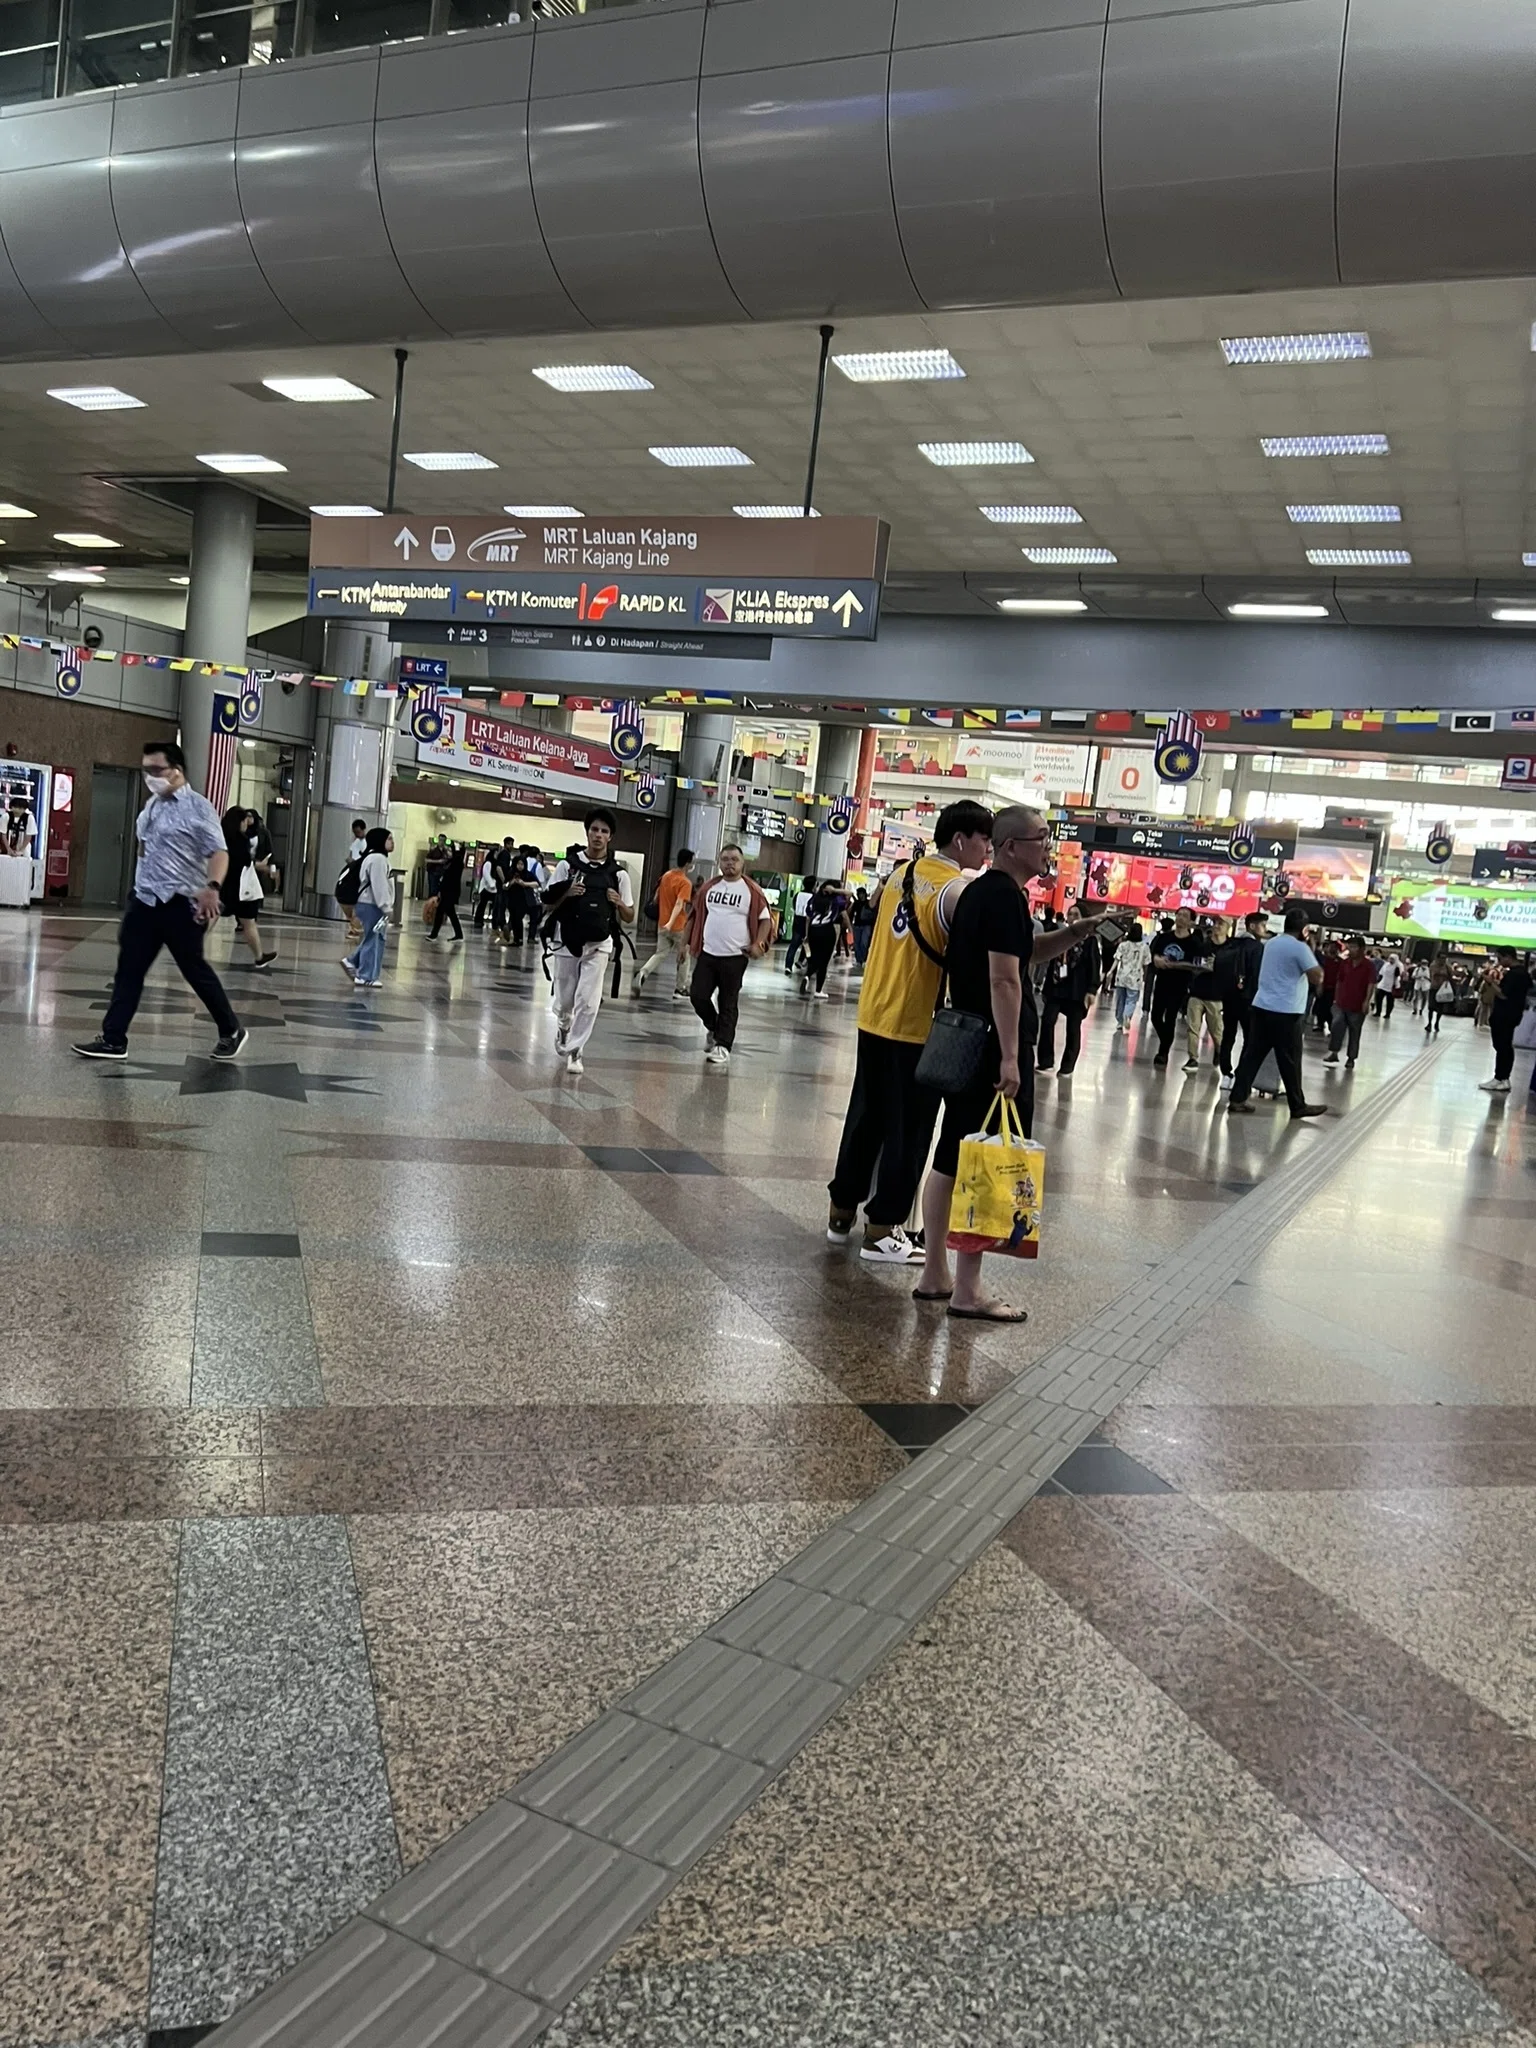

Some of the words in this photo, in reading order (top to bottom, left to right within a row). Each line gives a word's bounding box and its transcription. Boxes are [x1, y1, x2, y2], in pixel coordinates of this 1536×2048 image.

[543, 527, 578, 544] MRT
[582, 528, 636, 545] Laluan
[640, 528, 698, 549] Kajang
[485, 544, 520, 563] MRT
[544, 548, 578, 565] MRT
[582, 549, 633, 570] Kajang
[638, 549, 670, 566] Line
[341, 586, 371, 604] KTM
[371, 580, 451, 599] Antarabandar
[486, 589, 518, 607] KTM
[520, 591, 579, 609] Komuter
[735, 590, 771, 608] KLIA
[774, 590, 830, 612] Ekspres
[619, 593, 664, 612] RAPID
[667, 596, 687, 613] KL
[460, 627, 477, 636] Aras
[478, 628, 488, 643] 3
[610, 637, 619, 647] Di
[620, 638, 654, 649] Hadapan
[416, 664, 431, 673] LRT
[472, 719, 495, 739] LRT
[496, 726, 530, 749] Laluan
[532, 735, 565, 758] Kelana
[567, 746, 589, 763] Jaya
[983, 749, 1023, 759] moomoo
[487, 759, 496, 768] KL
[497, 760, 519, 774] Sentral
[1121, 767, 1140, 791] 0
